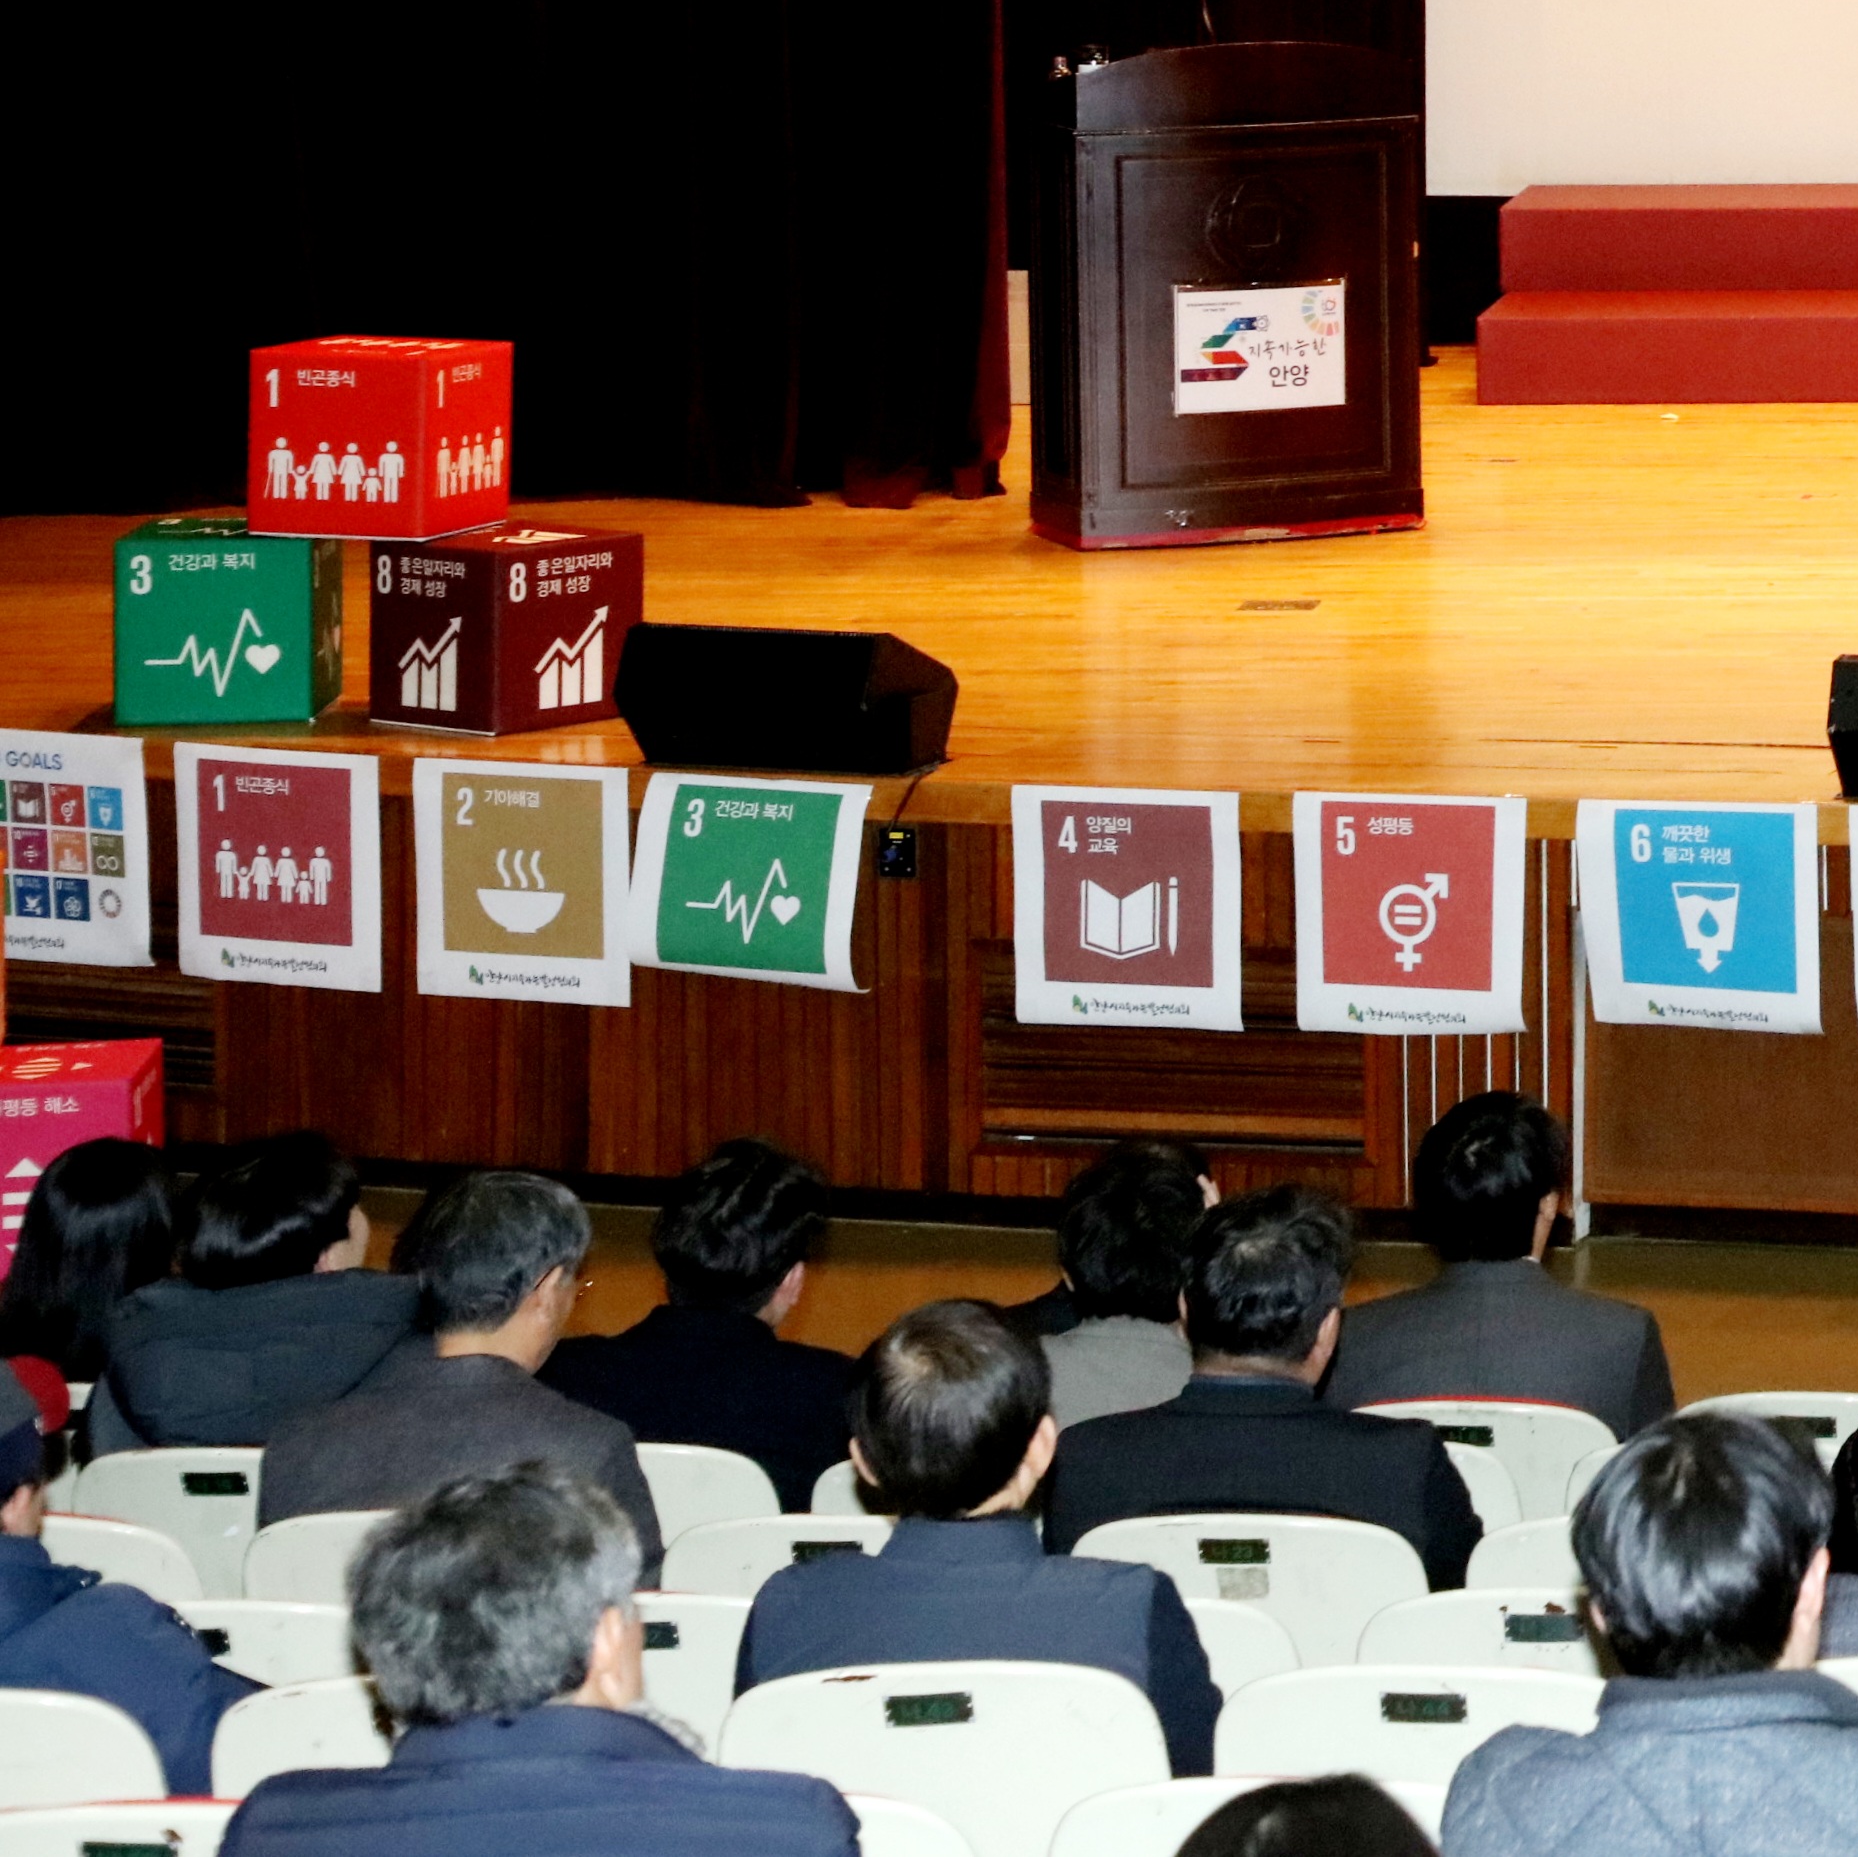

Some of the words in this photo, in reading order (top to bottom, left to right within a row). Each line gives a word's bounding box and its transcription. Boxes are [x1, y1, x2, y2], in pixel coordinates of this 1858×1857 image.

[1249, 338, 1327, 360] 지속가능한
[296, 368, 356, 389] 빈곤종식
[1269, 364, 1310, 387] 안양
[265, 369, 280, 408] 1
[436, 370, 445, 409] 1
[168, 552, 217, 572] 건강과
[222, 552, 256, 571] 복지
[129, 554, 153, 595] 3
[376, 555, 393, 594] 8
[508, 562, 527, 603] 8
[535, 577, 562, 598] 경제
[565, 574, 592, 595] 성장
[399, 576, 422, 596] 경제
[425, 579, 447, 599] 성장
[6, 751, 63, 770] GOALS
[212, 774, 226, 812] 1
[234, 775, 290, 796] 빈곤종식
[456, 787, 474, 826] 2
[484, 788, 540, 808] 기아해결
[684, 798, 705, 837] 3
[715, 799, 759, 820] 건강과
[762, 801, 793, 822] 복지
[1058, 816, 1078, 854] 4
[1085, 816, 1132, 835] 양질의
[1335, 816, 1356, 855] 5
[1367, 816, 1414, 836] 성평등
[1661, 824, 1710, 843] 깨끗한
[1087, 836, 1119, 855] 교육
[1630, 824, 1651, 863] 6
[1662, 845, 1695, 864] 물과
[1699, 845, 1732, 865] 위생
[44, 1096, 80, 1114] 해소
